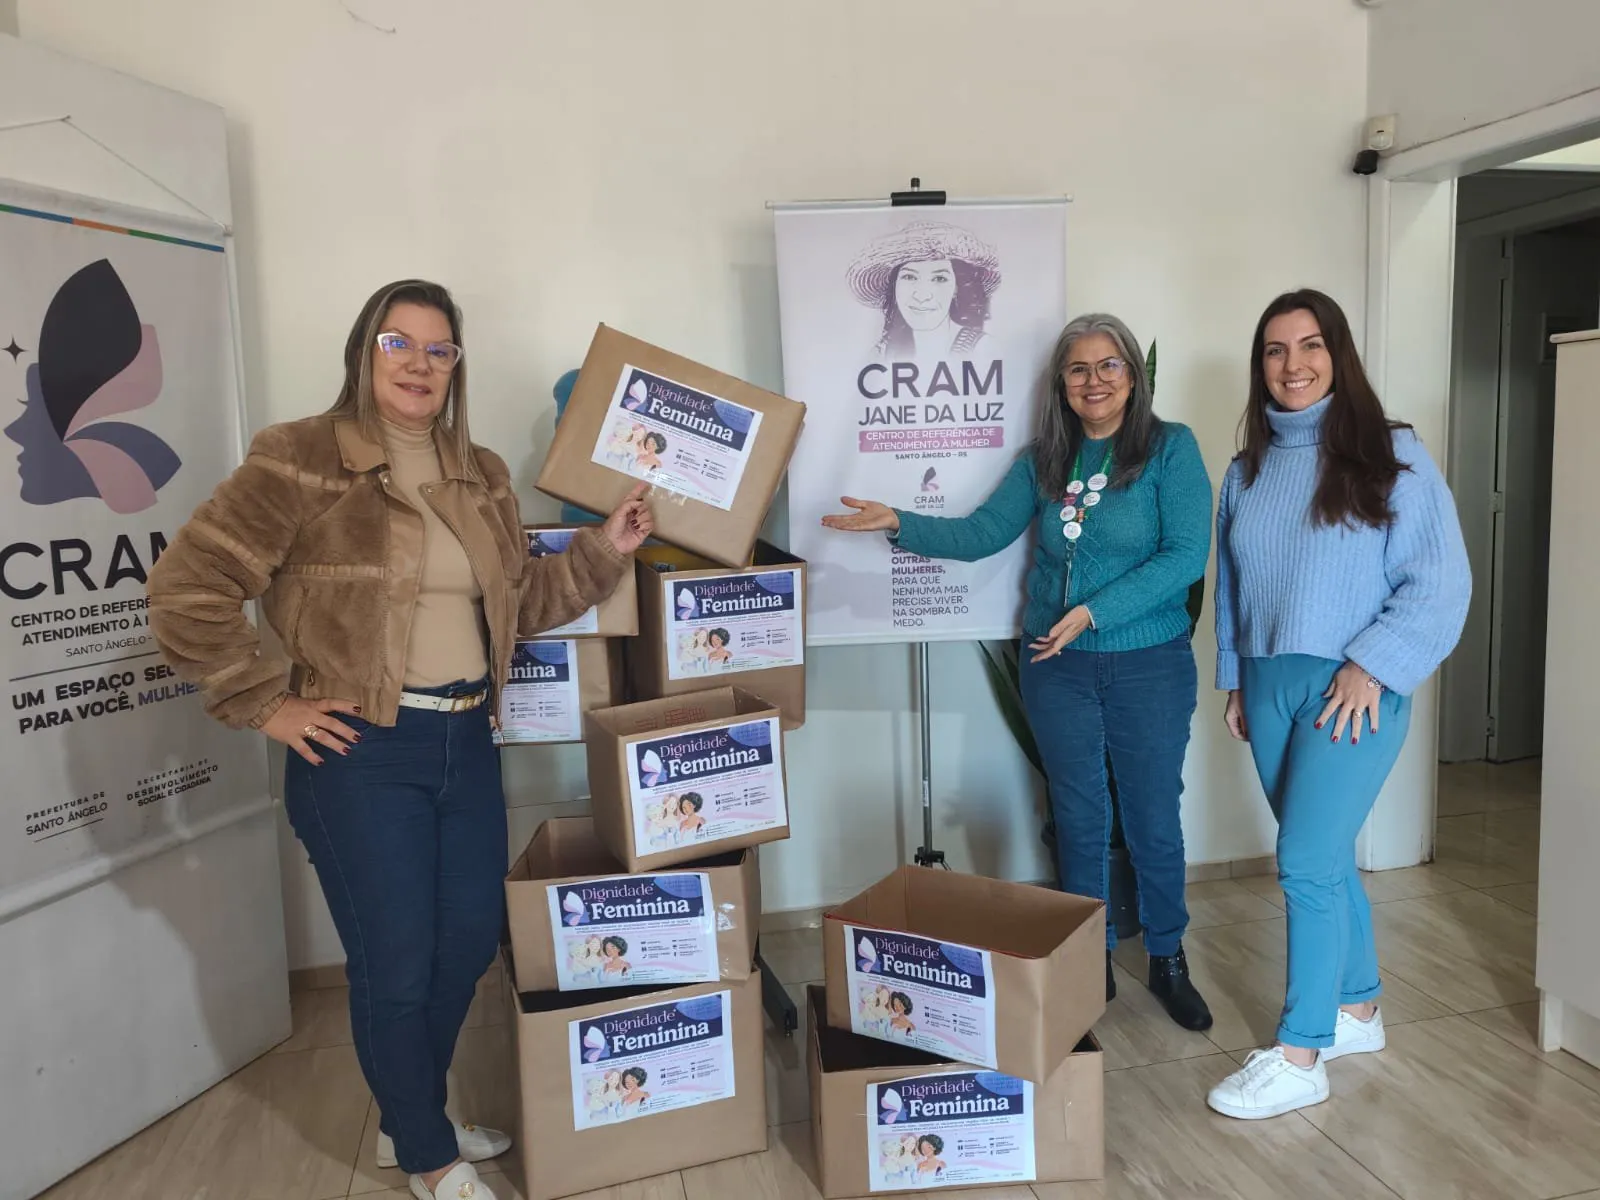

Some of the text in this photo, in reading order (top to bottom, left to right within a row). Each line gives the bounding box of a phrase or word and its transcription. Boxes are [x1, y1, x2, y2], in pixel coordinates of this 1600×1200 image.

[857, 359, 1003, 399] CRAM
[648, 382, 711, 412] Dignidade
[648, 398, 734, 442] Feminina
[858, 402, 1004, 426] JANE DA LUZ
[866, 427, 995, 442] CENTRO DE REFERÊNCIA DE
[872, 440, 940, 451] ATENDIMENTO
[951, 438, 990, 448] MULHER
[914, 495, 945, 504] CRAM
[891, 565, 946, 575] MULHERES,
[892, 575, 941, 585] PARA QUE
[694, 580, 754, 598] Dignidade
[892, 595, 963, 606] PRECISE VIVER
[893, 585, 969, 596] NENHUMA MAIS
[11, 595, 151, 628] CENTRO DE REFERÊ
[701, 592, 783, 614] Feminina
[893, 605, 969, 617] NA SOMBRA DO
[22, 618, 129, 646] ATENDIMENTO
[133, 614, 143, 628] À
[893, 618, 926, 628] MEDO.
[65, 643, 103, 657] SANTO
[104, 635, 146, 651] ÂNGELO
[507, 661, 557, 679] inina
[12, 688, 45, 710] UM
[55, 671, 135, 701] ESPAÇO
[19, 682, 200, 734] PARA VOCÊ, MULHE
[659, 734, 727, 759] Dignidade
[668, 747, 760, 778] Feminina
[126, 764, 219, 801] DESENVOLVIMENTO
[26, 791, 105, 821] PREFEITURA DE
[137, 791, 166, 807] SOCIAL
[167, 788, 173, 796] E
[26, 802, 108, 836] SANTO ÂNGELO
[582, 883, 654, 902] Dignidade
[590, 896, 690, 920] Feminina
[875, 936, 940, 960] Dignidade
[881, 953, 972, 989] Feminina
[604, 1009, 676, 1035] Dignidade
[612, 1021, 710, 1054] Feminina
[901, 1080, 975, 1099] Dignidade
[909, 1094, 1010, 1118] Feminina
